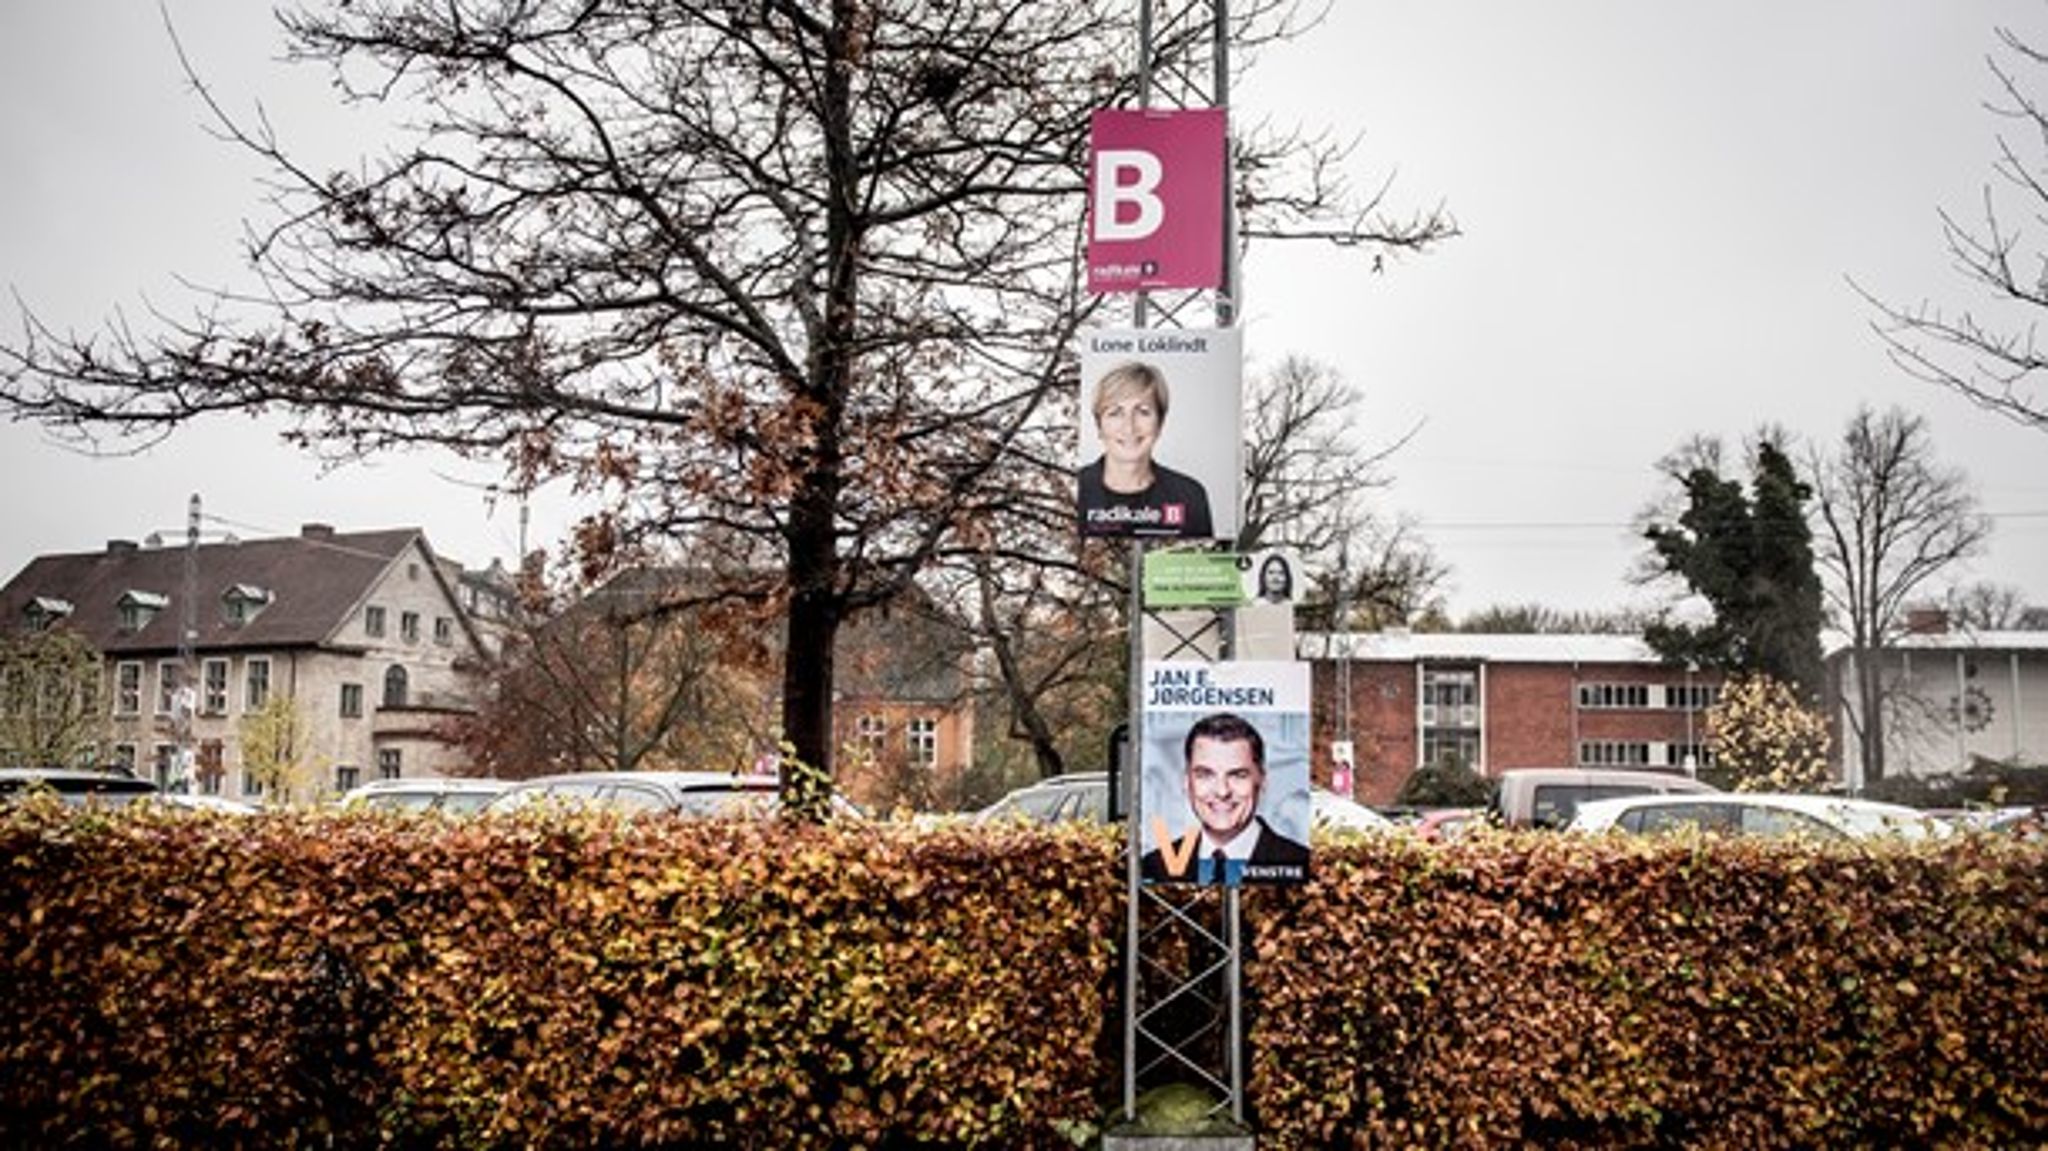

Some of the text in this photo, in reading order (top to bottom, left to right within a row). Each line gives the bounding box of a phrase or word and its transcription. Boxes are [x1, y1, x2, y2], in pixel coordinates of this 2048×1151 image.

[1094, 149, 1164, 241] B
[1091, 336, 1208, 352] Lone Loklindt
[1087, 505, 1161, 523] radikale
[1149, 669, 1190, 687] JAN
[1149, 687, 1274, 706] JØRGENSEN
[1240, 865, 1303, 879] VENSTRE
